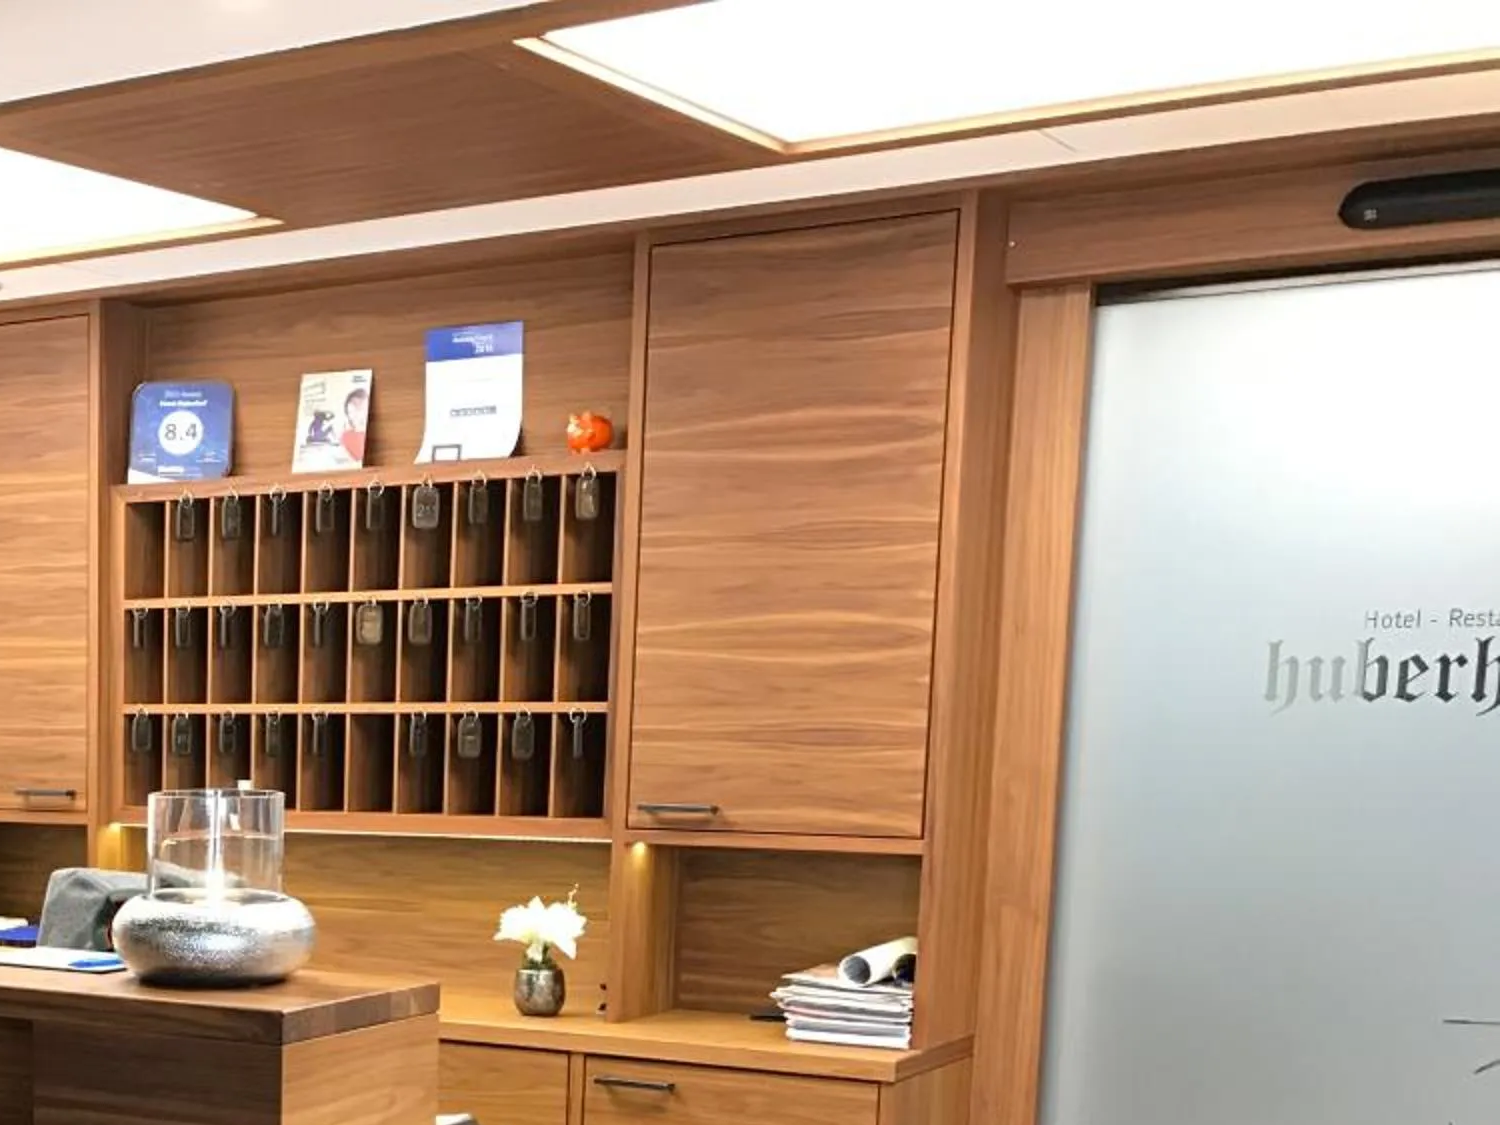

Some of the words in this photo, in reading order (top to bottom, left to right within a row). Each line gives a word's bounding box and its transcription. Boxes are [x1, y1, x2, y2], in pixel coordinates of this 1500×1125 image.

[164, 423, 197, 441] 8.4
[1364, 608, 1421, 629] Hotel
[1263, 635, 1500, 717] huberh
